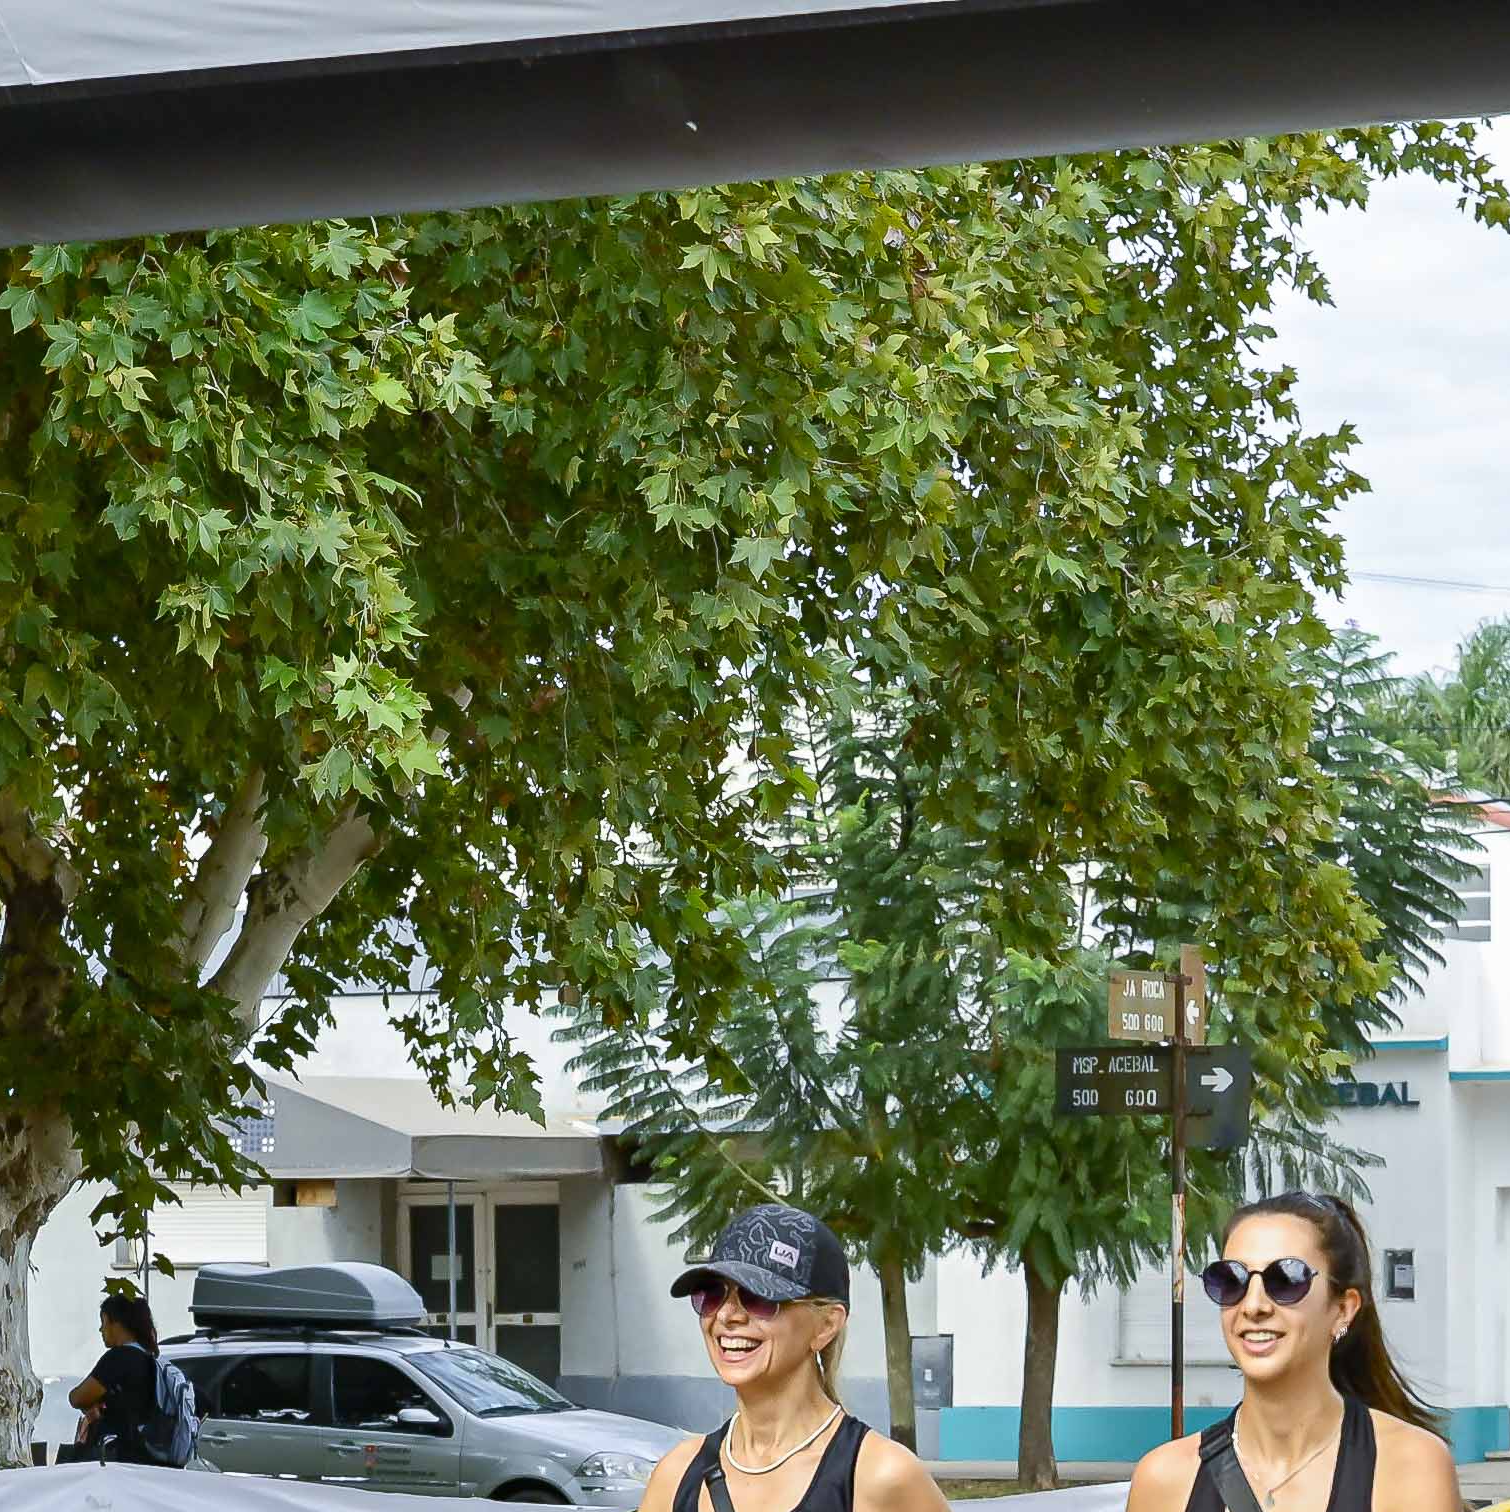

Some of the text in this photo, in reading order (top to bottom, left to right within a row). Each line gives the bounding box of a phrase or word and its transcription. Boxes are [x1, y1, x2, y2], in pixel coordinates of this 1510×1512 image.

[1141, 980, 1165, 1000] ROCA
[1122, 1013, 1164, 1033] 500 600
[1108, 1055, 1159, 1073] ACEBAL
[1072, 1089, 1157, 1106] 500 600
